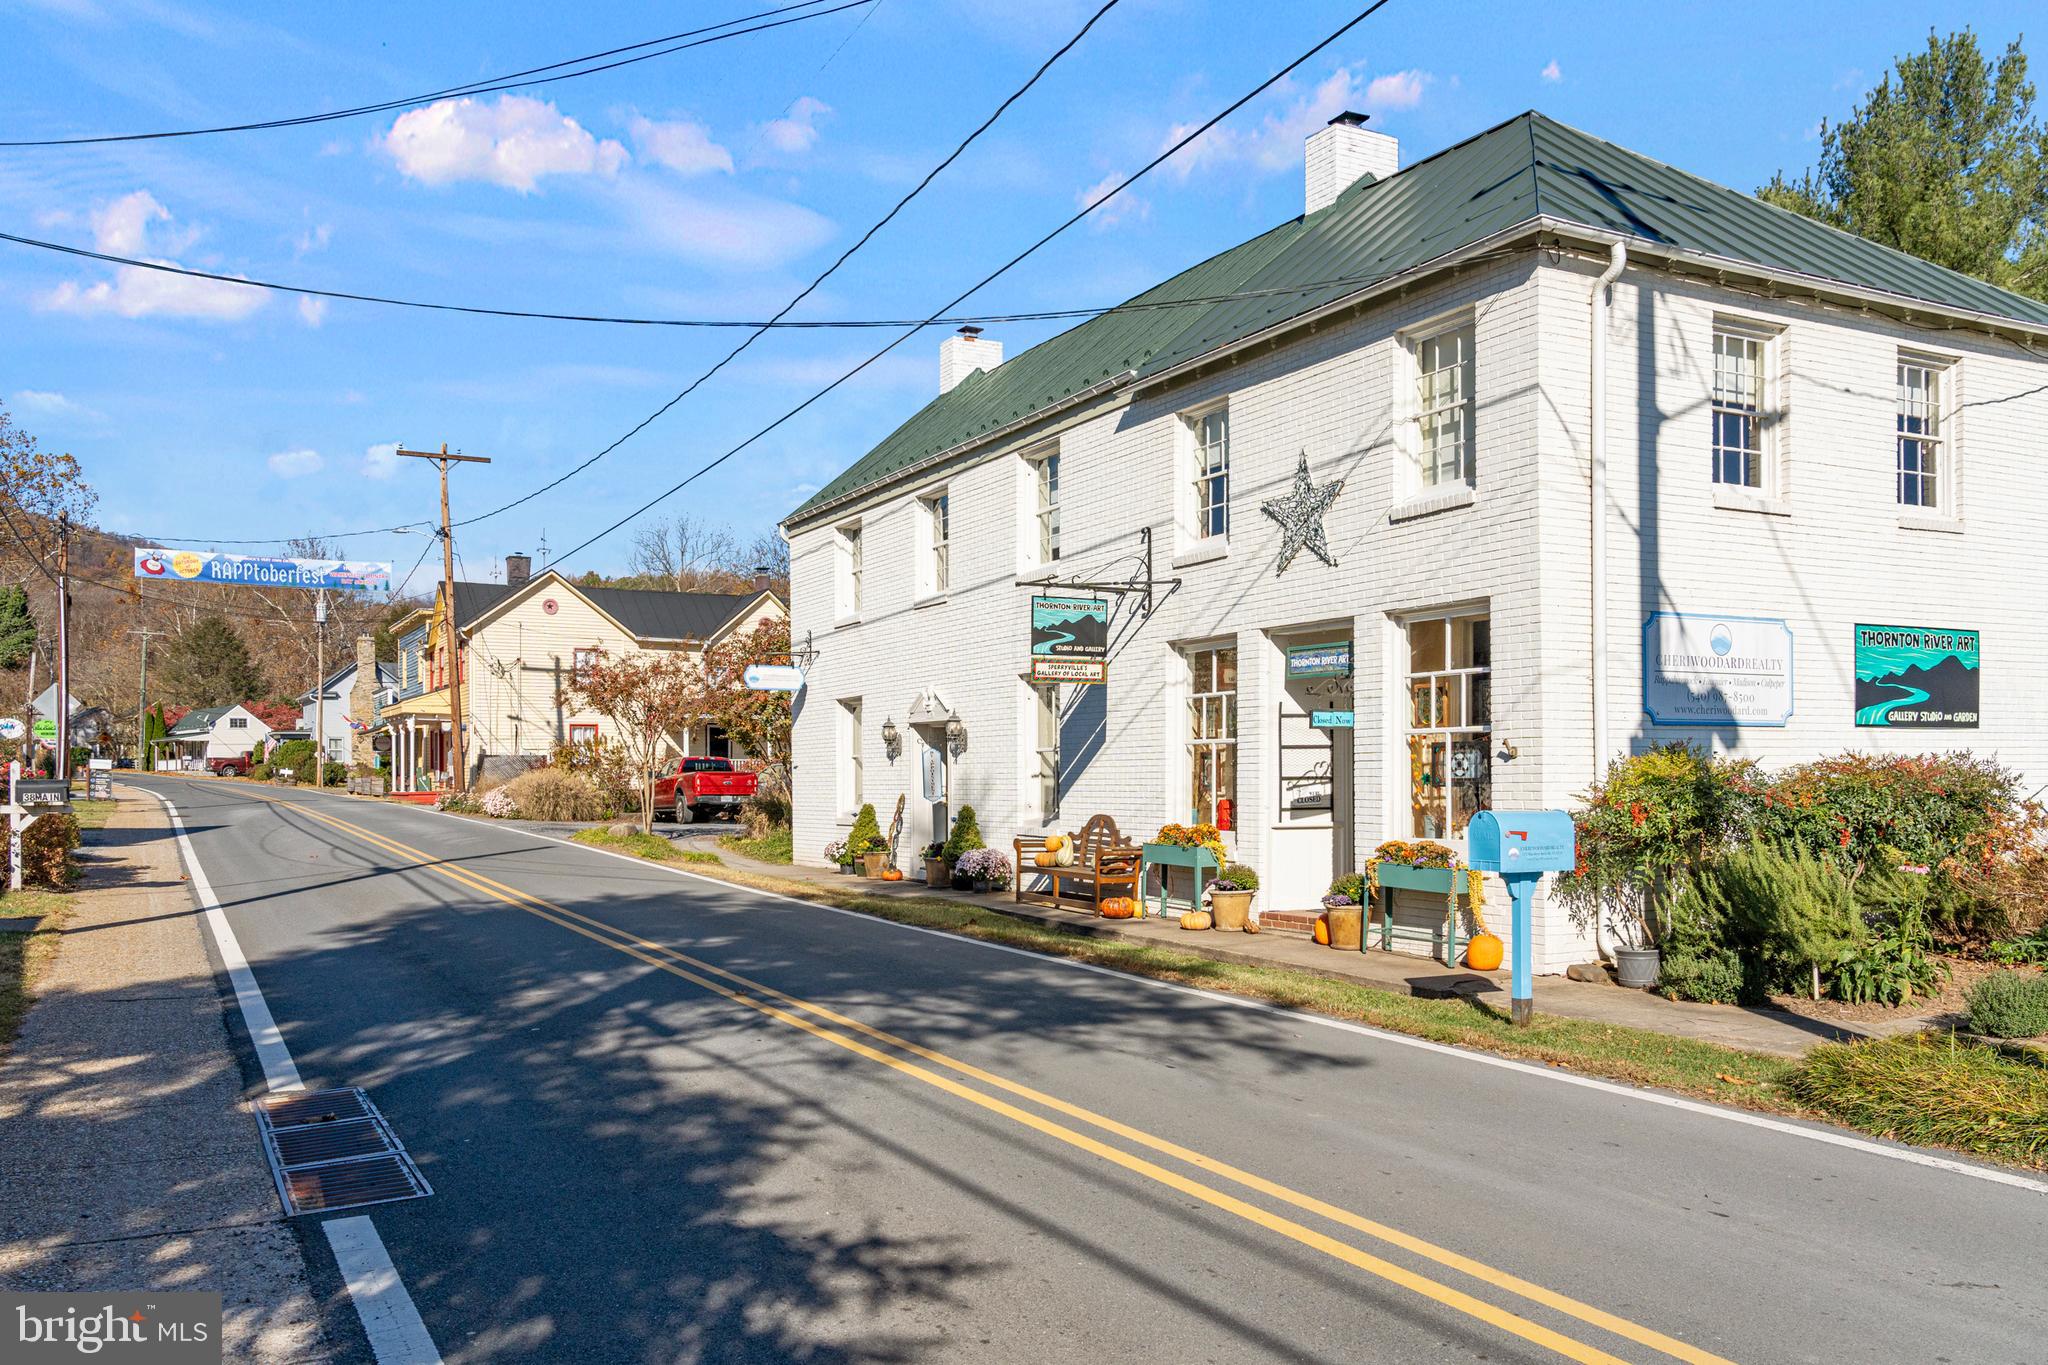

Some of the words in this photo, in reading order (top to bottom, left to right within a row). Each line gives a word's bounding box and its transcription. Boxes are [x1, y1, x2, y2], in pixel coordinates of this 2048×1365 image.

[211, 559, 326, 585] RAPPtoberfest
[1036, 602, 1071, 610] THORNTON
[1072, 603, 1091, 611] RIVER
[1093, 604, 1105, 612] ART
[1861, 631, 1920, 648] THORNTON
[1956, 636, 1975, 651] ART
[1291, 655, 1321, 668] THORNTON
[1321, 655, 1338, 666] RIVER
[1338, 654, 1350, 664] ART
[1687, 692, 1710, 704] (540)
[1713, 692, 1755, 704] 987-8500
[1313, 714, 1332, 724] Closed
[1335, 715, 1351, 724] Now
[1888, 711, 1918, 722] GALLERY
[1953, 713, 1978, 722] GARDEN
